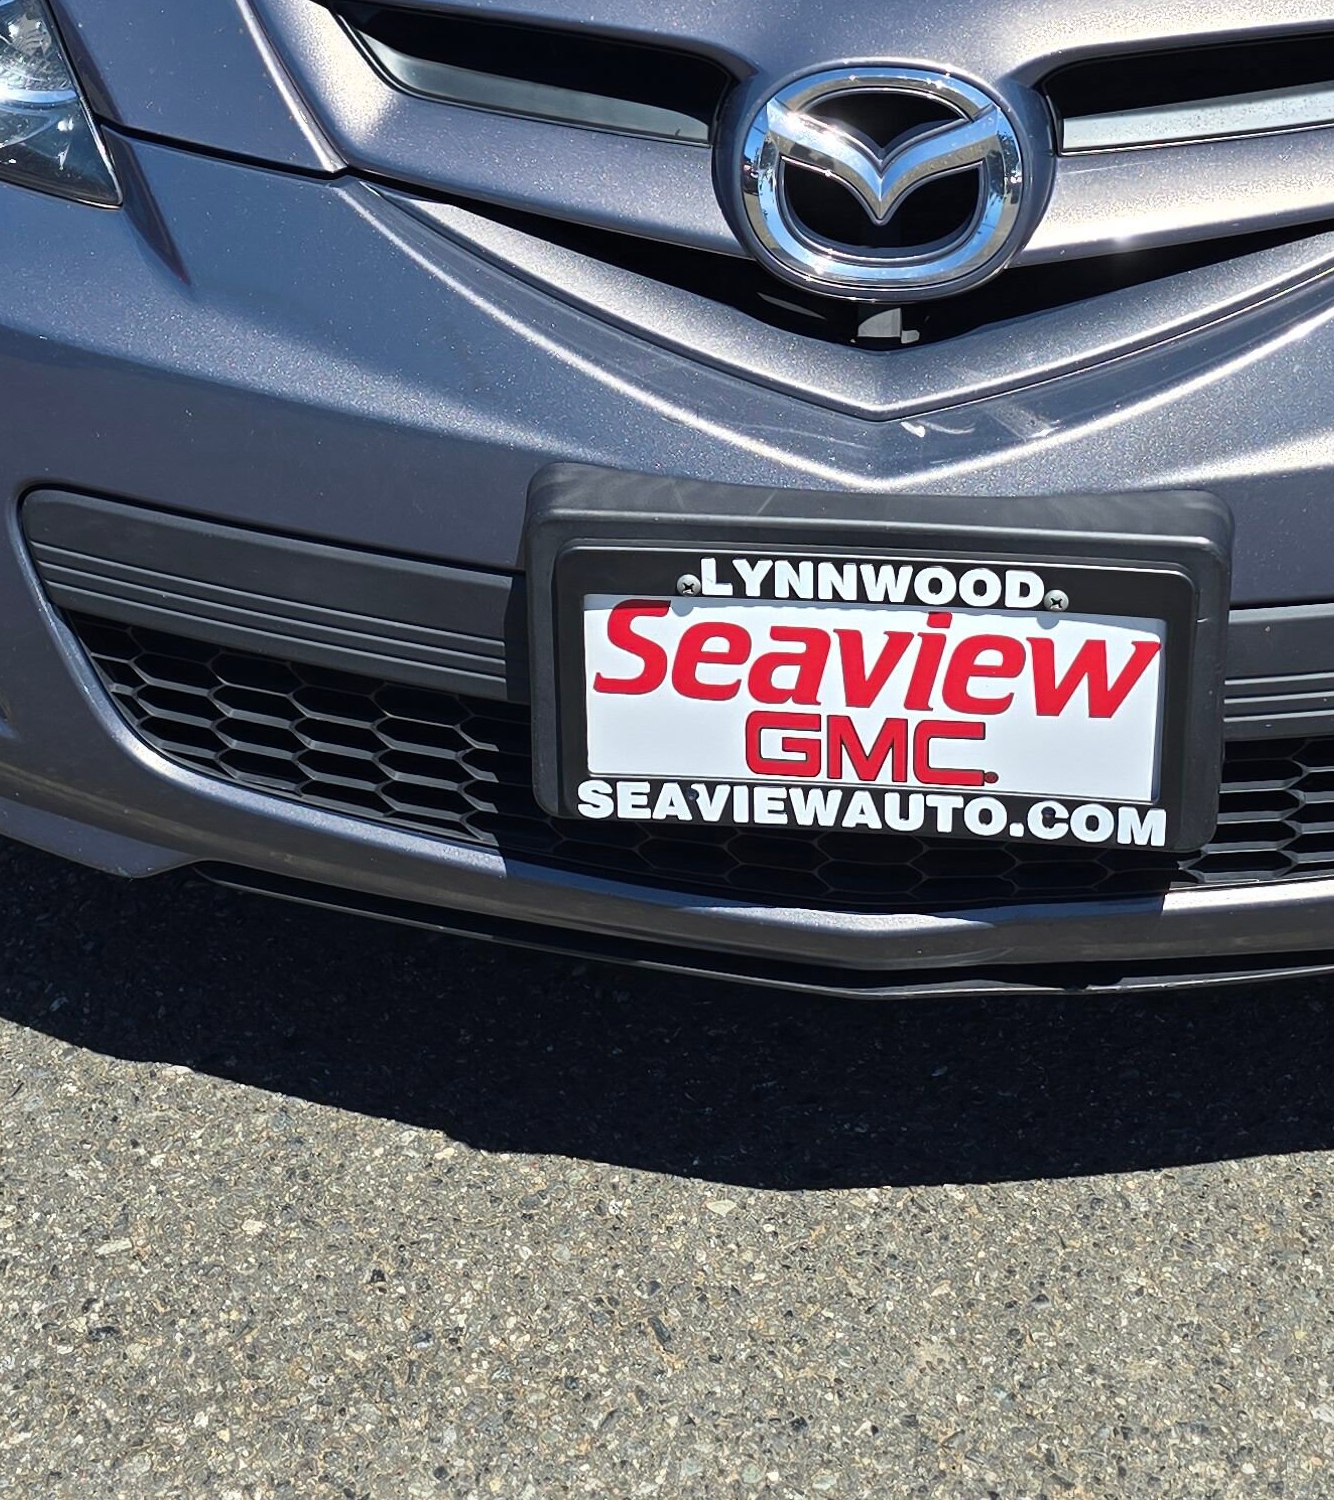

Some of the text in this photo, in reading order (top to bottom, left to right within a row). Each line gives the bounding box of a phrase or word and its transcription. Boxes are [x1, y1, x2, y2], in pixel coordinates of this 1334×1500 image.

[700, 557, 1047, 610] LYNNWOOD
[592, 599, 1163, 719] Seaview
[745, 710, 989, 787] GMC
[577, 779, 1167, 847] SEAVIEWAUTO.COM
